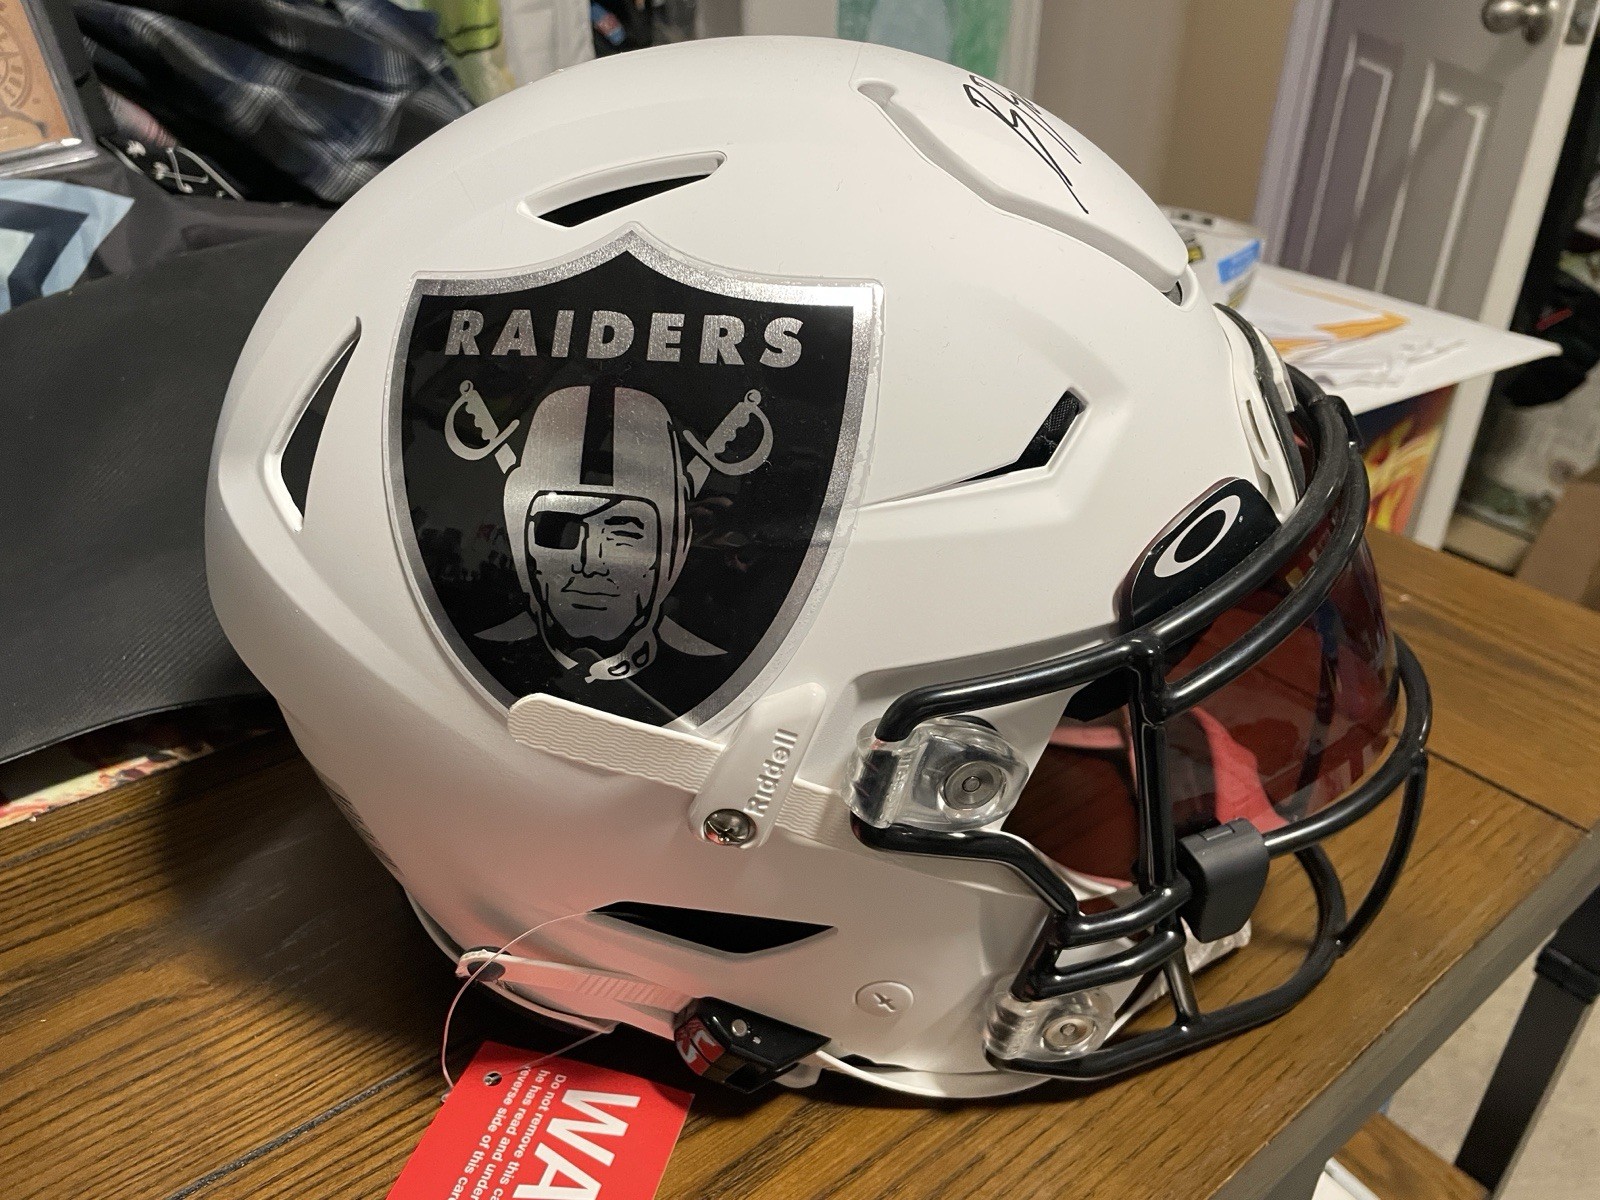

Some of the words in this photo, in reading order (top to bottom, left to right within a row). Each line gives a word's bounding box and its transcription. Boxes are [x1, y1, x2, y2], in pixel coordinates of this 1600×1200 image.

[445, 309, 803, 368] RAIDERS
[743, 729, 798, 817] Riddell
[534, 1069, 551, 1083] he
[550, 1074, 567, 1090] Do
[521, 1085, 542, 1106] has
[538, 1091, 555, 1111] not
[487, 1107, 508, 1132] side
[505, 1107, 527, 1136] read
[478, 1134, 492, 1150] of
[512, 1089, 641, 1200] WA
[513, 1112, 544, 1158] remove
[491, 1136, 511, 1162] and
[463, 1150, 485, 1175] this
[499, 1161, 520, 1185] this
[447, 1176, 469, 1200] car
